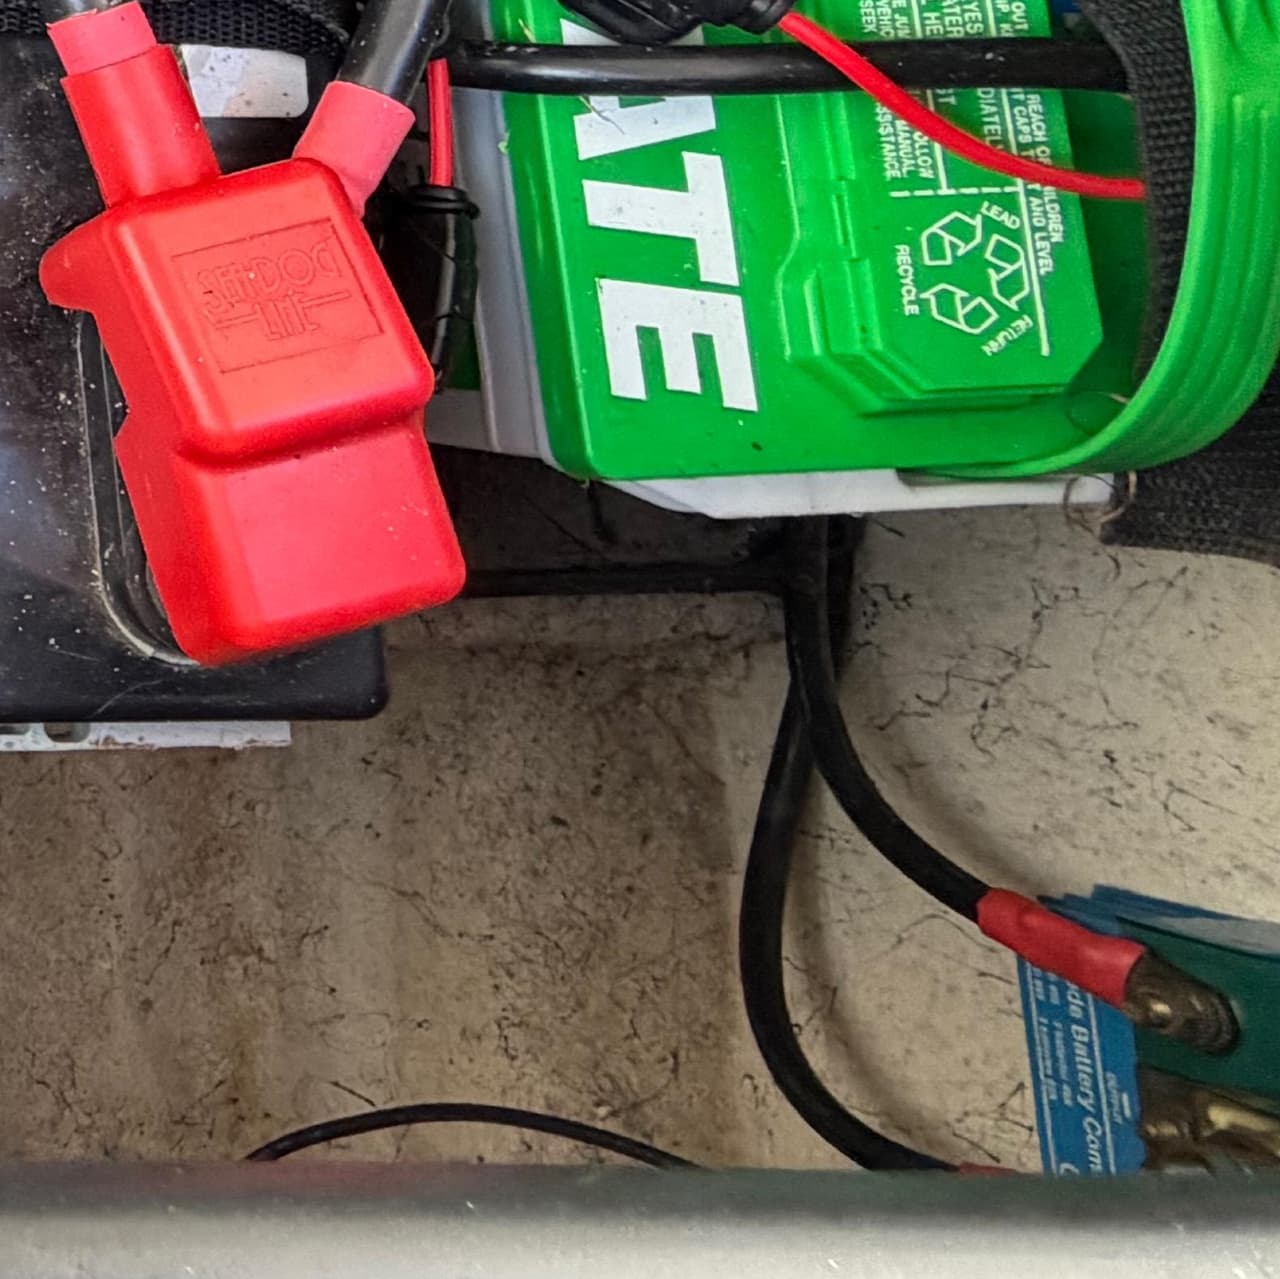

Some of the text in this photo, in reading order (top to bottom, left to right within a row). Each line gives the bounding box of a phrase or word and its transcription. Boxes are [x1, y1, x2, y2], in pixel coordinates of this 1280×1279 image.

[1008, 1, 1028, 31] OUT
[981, 201, 1021, 230] LEAD
[894, 244, 919, 315] RECYCLE
[981, 314, 1034, 357] RETURN
